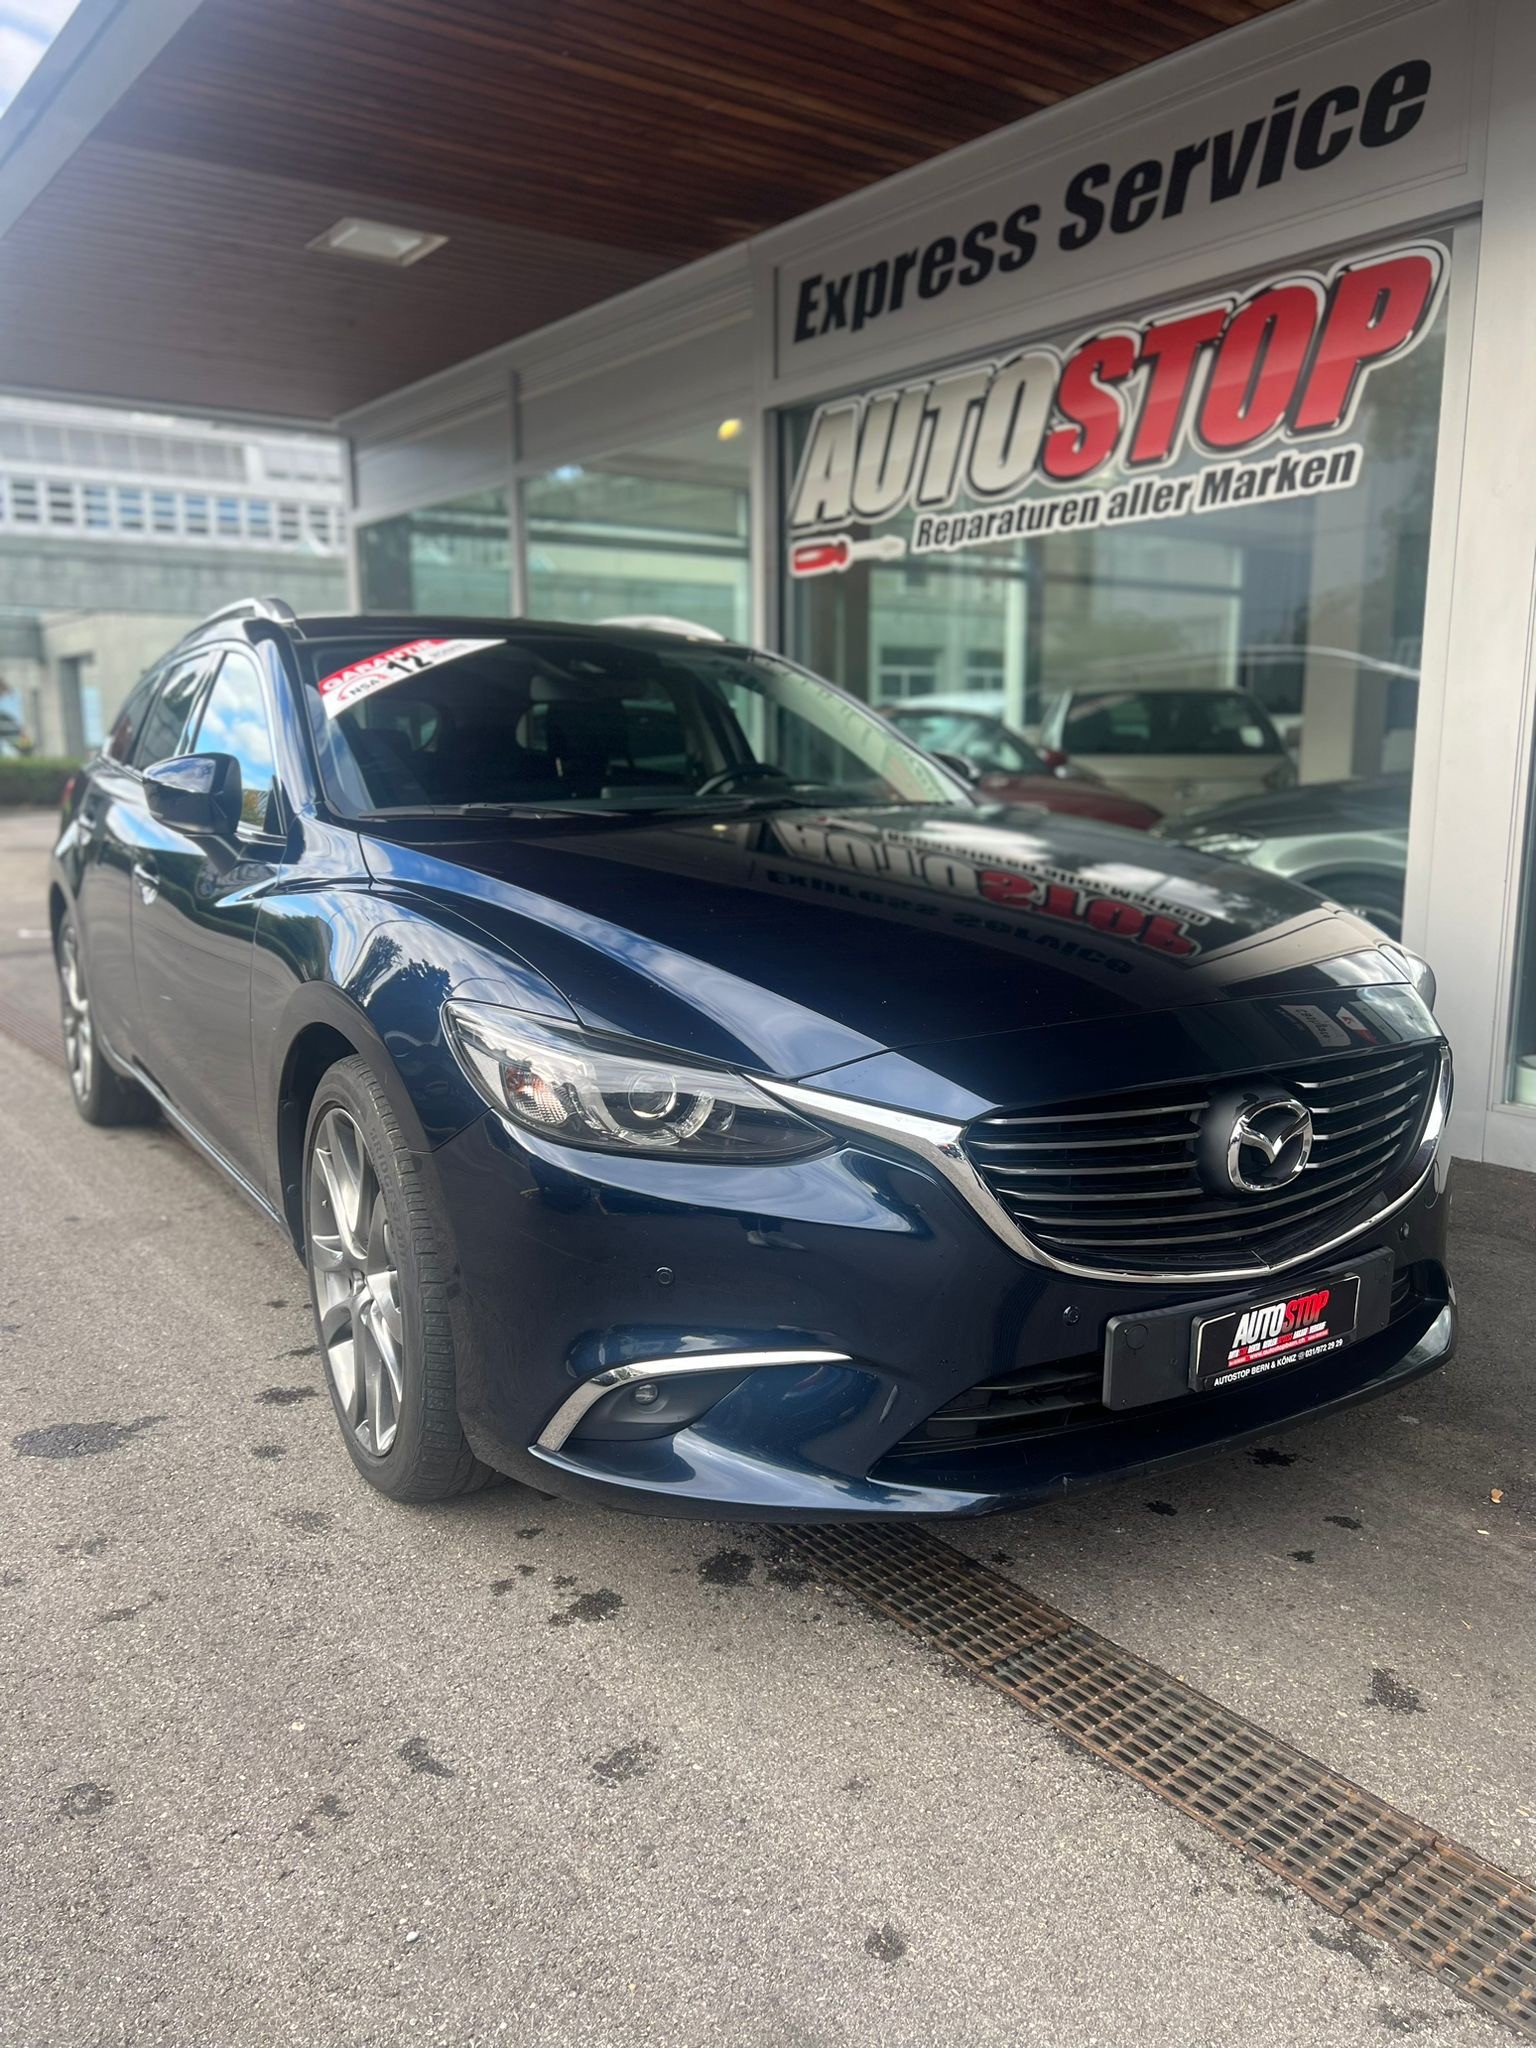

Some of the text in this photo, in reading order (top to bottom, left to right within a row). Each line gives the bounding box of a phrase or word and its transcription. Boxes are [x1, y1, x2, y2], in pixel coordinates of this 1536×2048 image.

[794, 59, 1432, 344] Express Service
[790, 243, 1447, 531] AUTOSTOP
[916, 448, 1357, 550] Reparaturen aller Marken
[387, 654, 433, 674] 12
[1231, 1289, 1330, 1349] AUTOSTOP
[1213, 1368, 1250, 1386] AUTOSTOP
[1251, 1362, 1270, 1376] BERN
